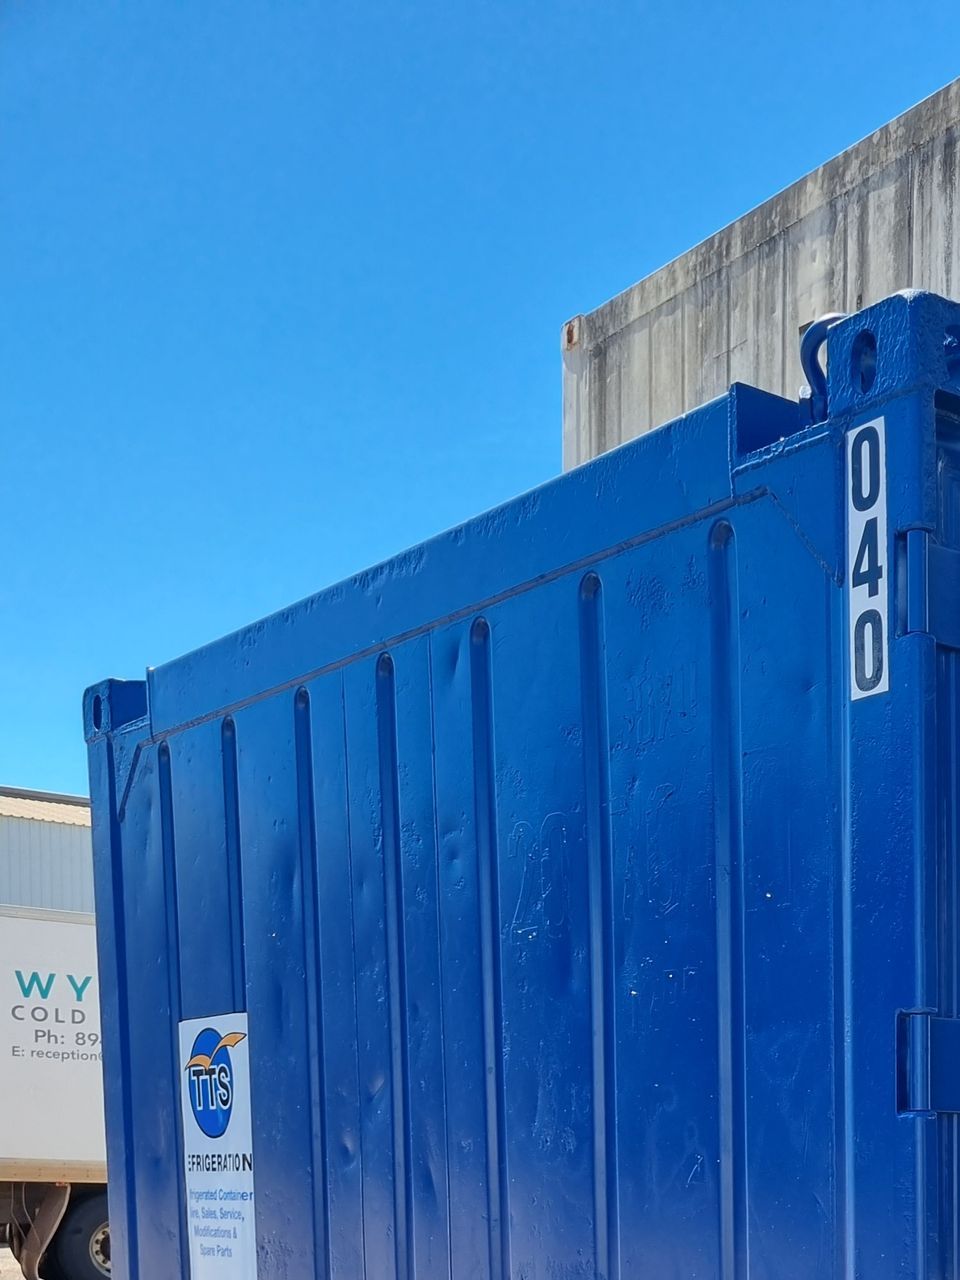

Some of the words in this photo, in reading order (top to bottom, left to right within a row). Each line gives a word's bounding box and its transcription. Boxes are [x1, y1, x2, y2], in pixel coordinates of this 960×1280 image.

[851, 425, 884, 693] 040
[11, 1005, 86, 1024] COLD
[34, 1029, 65, 1045] Ph:
[75, 1031, 102, 1047] 89
[12, 1045, 25, 1057] E:
[188, 1065, 231, 1111] TTS
